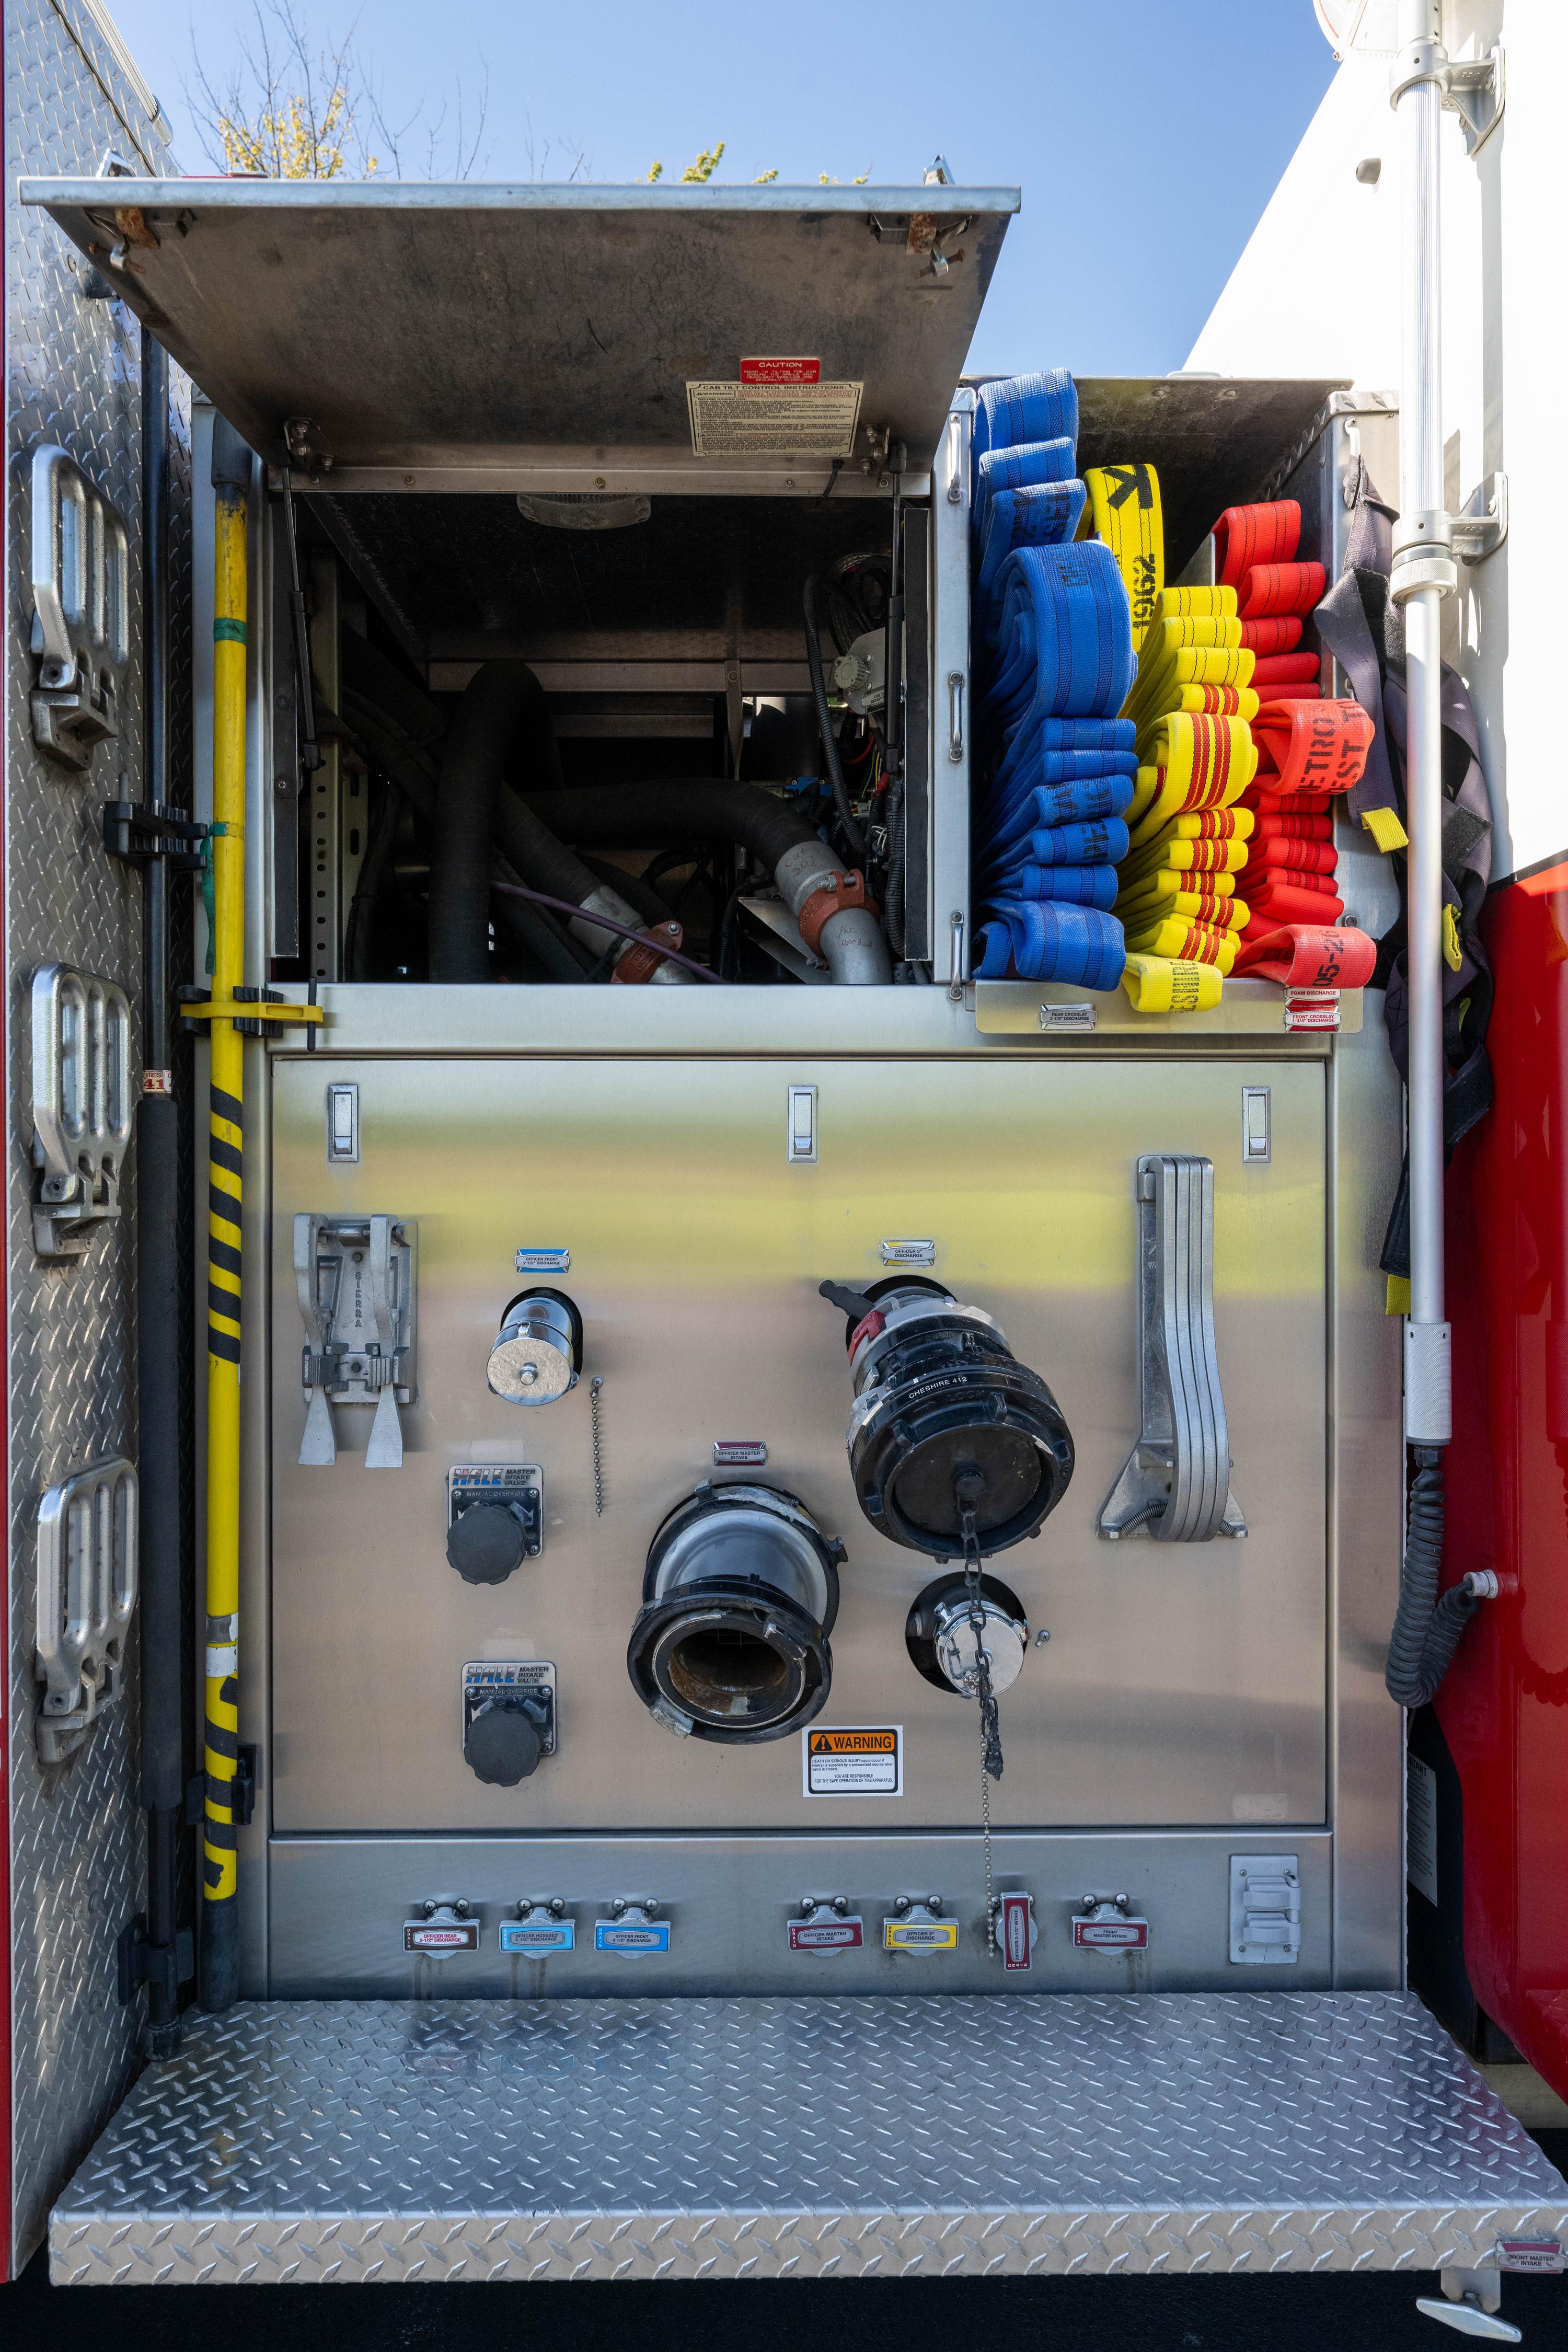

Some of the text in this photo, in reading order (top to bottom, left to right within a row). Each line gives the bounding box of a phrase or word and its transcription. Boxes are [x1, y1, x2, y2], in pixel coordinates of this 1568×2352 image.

[909, 1379, 951, 1399] CHESHIRE
[453, 1469, 504, 1485] HALE
[466, 1666, 517, 1683] HALE
[834, 1736, 892, 1749] WARNING
